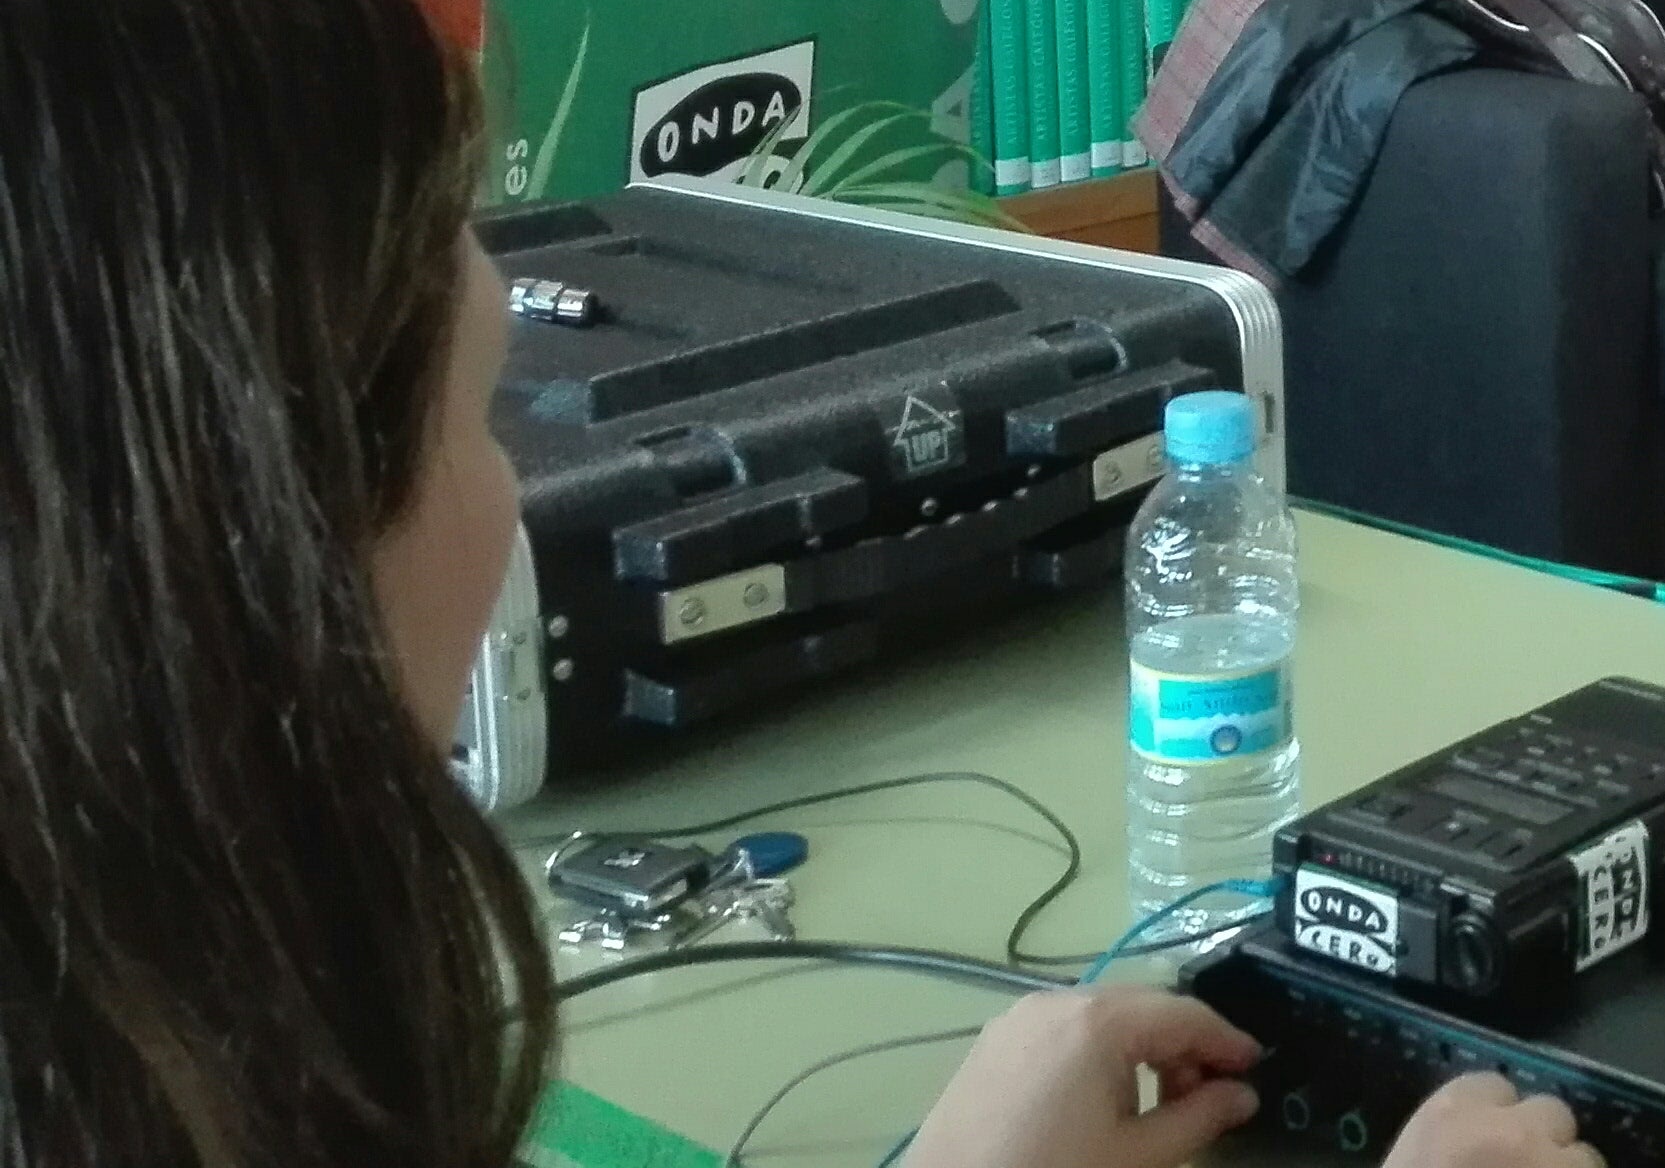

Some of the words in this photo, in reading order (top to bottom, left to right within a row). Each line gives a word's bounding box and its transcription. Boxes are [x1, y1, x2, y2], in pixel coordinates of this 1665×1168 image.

[657, 91, 786, 162] ONDA
[911, 430, 941, 462] UP
[1308, 890, 1381, 931] ONDA
[1311, 930, 1379, 967] CERO
